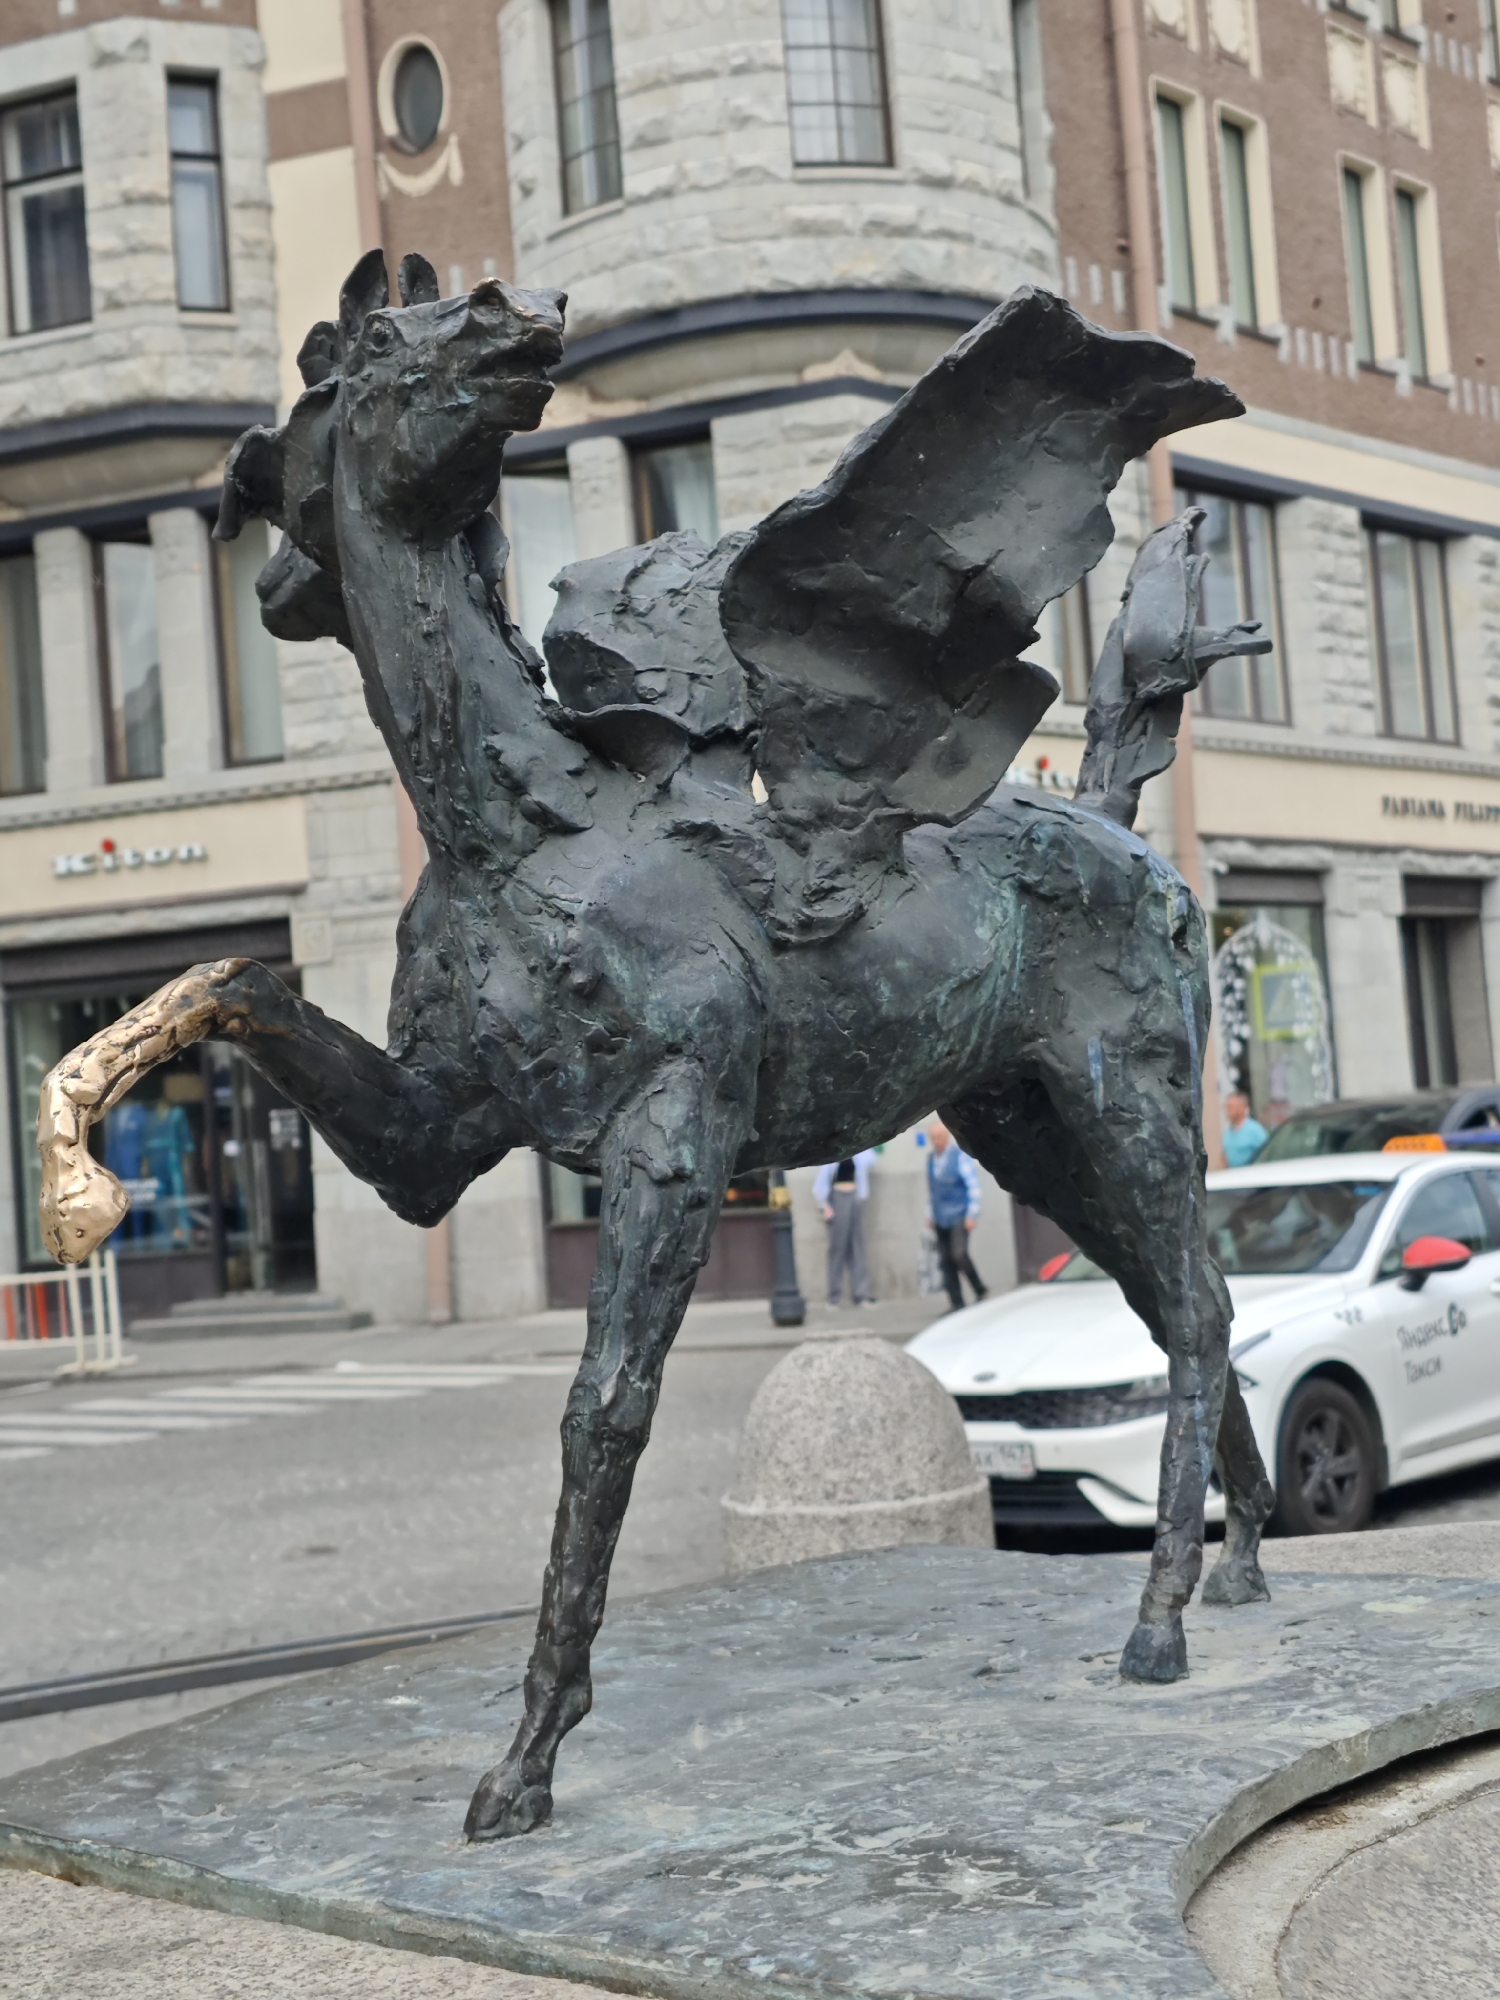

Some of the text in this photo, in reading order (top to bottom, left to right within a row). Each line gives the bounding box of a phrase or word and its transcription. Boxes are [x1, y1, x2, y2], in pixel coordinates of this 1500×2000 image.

[1003, 755, 1079, 790] Kit
[54, 838, 208, 878] Kiton
[1396, 1315, 1448, 1352] Яндекс
[1403, 1355, 1442, 1386] Такси
